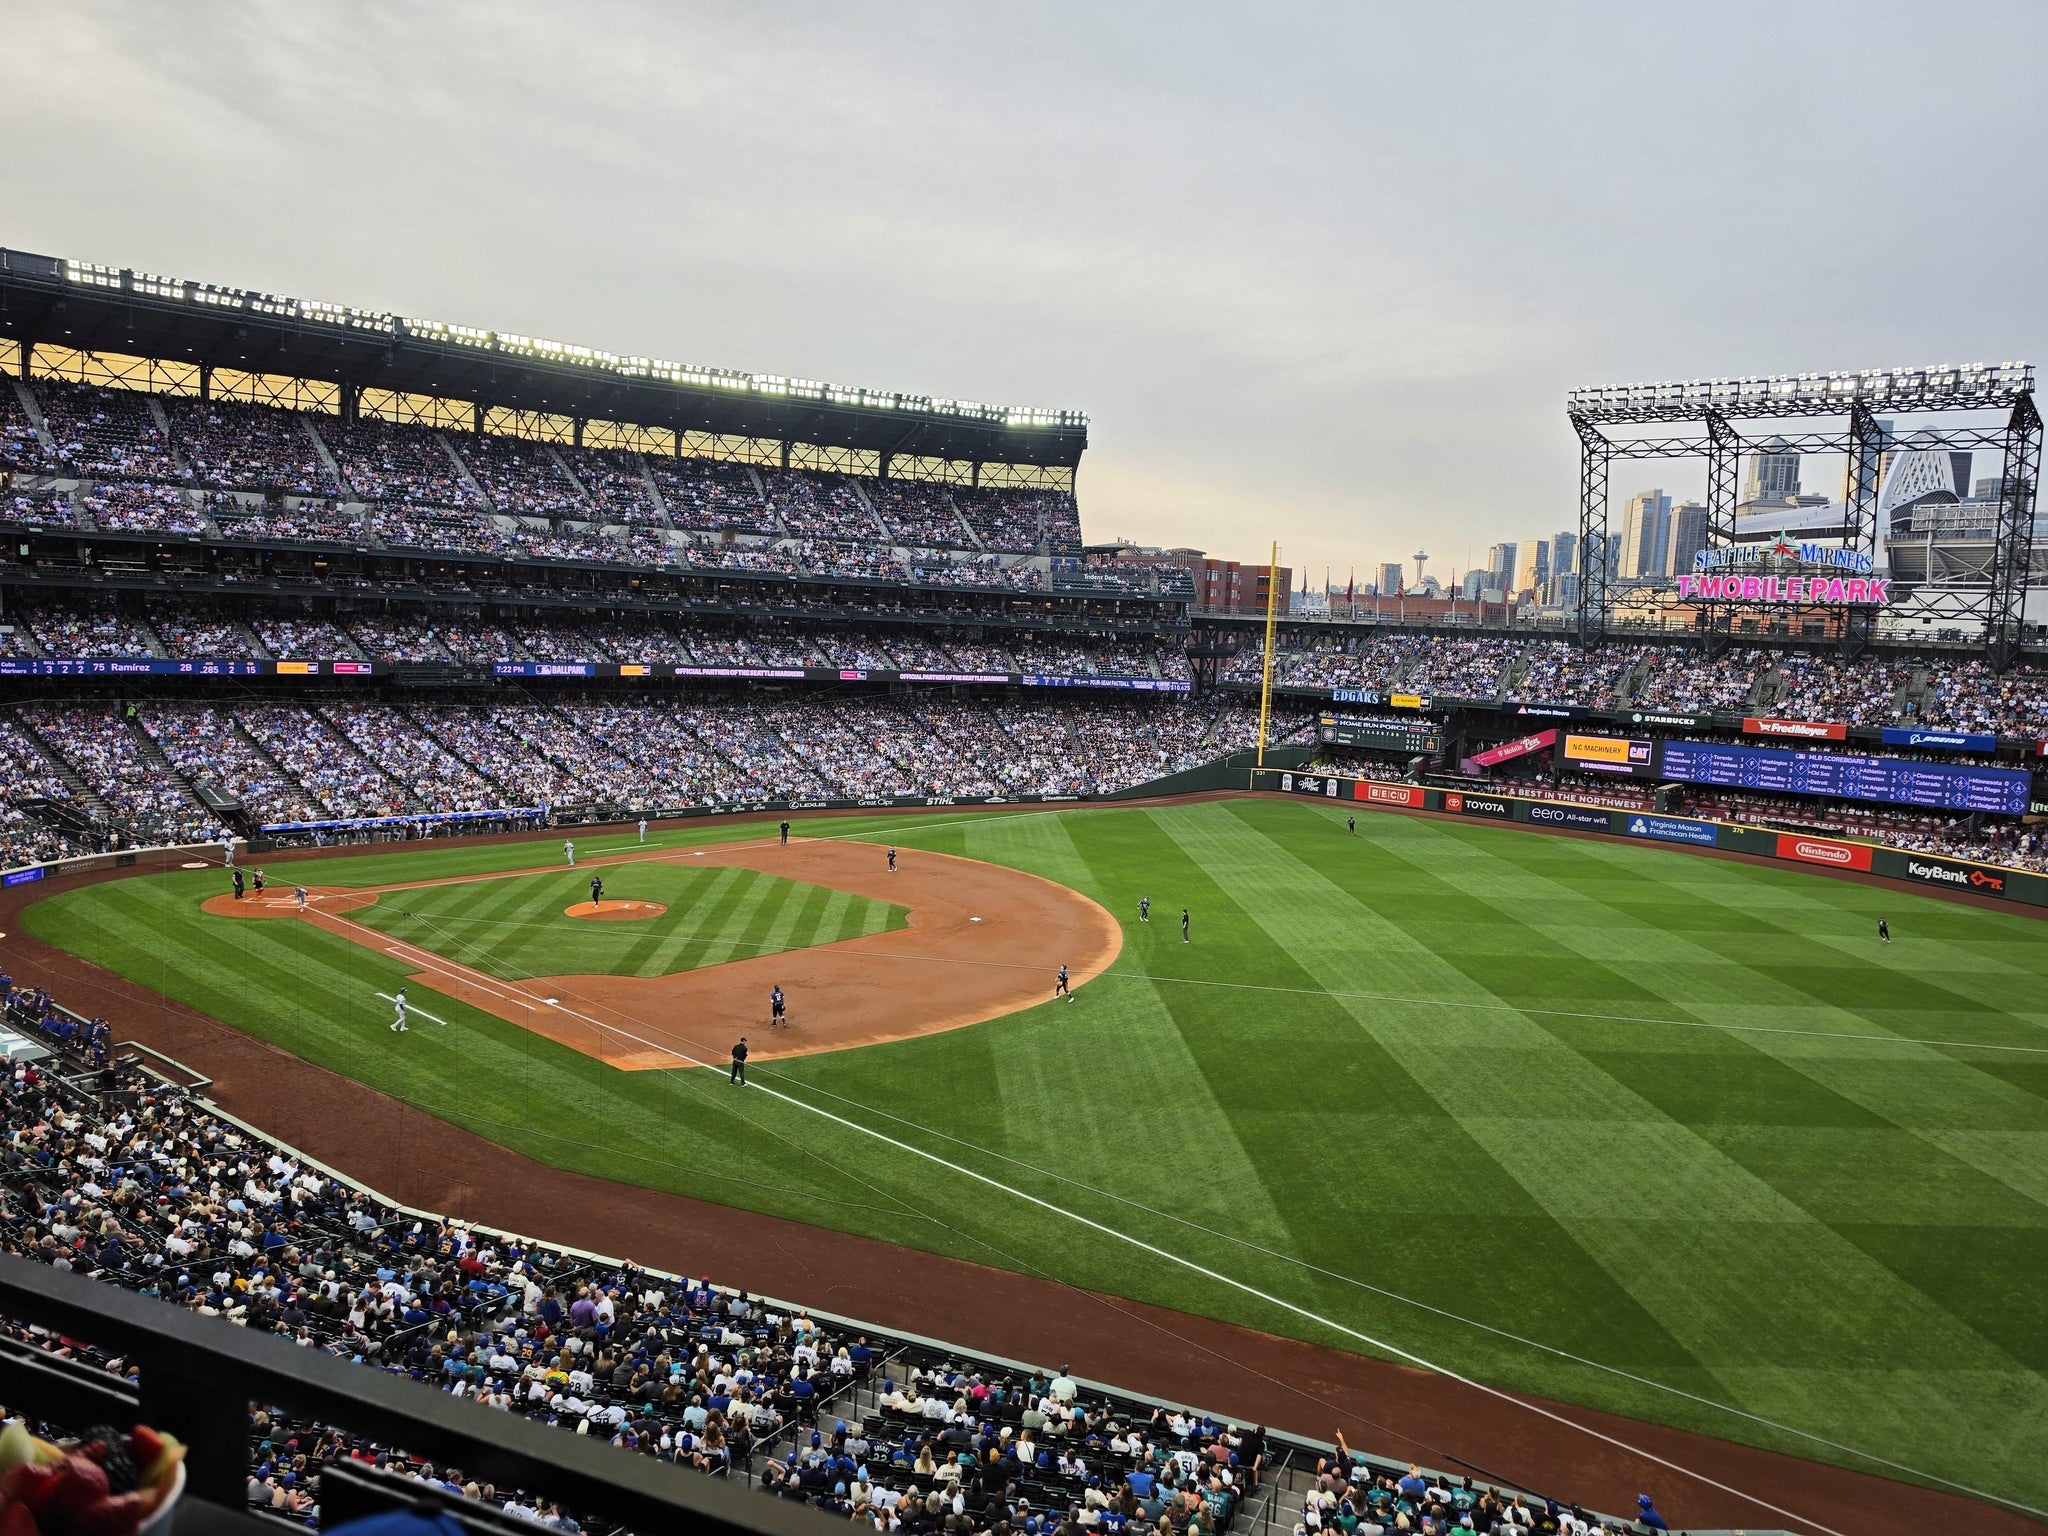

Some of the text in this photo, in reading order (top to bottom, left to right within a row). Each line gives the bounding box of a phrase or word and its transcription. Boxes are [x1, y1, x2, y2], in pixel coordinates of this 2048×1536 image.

[1695, 542, 1873, 574] SEATTLE MARINERS
[1677, 575, 1892, 603] T-MOBILE PARK
[46, 666, 84, 674] 3 2 2
[93, 663, 150, 672] 75 Ramírez
[180, 663, 192, 672] 2B
[200, 666, 256, 674] .285 2 15
[552, 665, 586, 675] BALLPARK
[1332, 689, 1380, 705] EDGARS
[1528, 708, 1569, 717] Benjamin Moore
[1644, 715, 1695, 725] STARBUCKS
[1340, 720, 1362, 728] HOME
[1380, 723, 1408, 731] PORCH
[1923, 735, 1966, 745] BOEING
[1503, 744, 1523, 756] Mobile
[1584, 744, 1622, 754] MACHINERY
[1629, 746, 1650, 759] CAT
[1823, 755, 1866, 765] SCOREBOARD
[1915, 789, 1942, 797] Cincinnati
[1984, 786, 2001, 794] Diego
[877, 798, 893, 806] Clips
[926, 797, 955, 805] STIHL
[1518, 789, 1542, 798] BEST
[1557, 793, 1576, 802] THE
[1579, 795, 1643, 810] NORTHWEST
[1970, 794, 2000, 803] Pittsburgh
[1466, 800, 1505, 813] TOYOTA
[1531, 807, 1564, 821] eero
[1566, 813, 1608, 825] All-star wifi.
[1649, 821, 1702, 832] Virginia Mason
[1649, 828, 1712, 841] Franciscan Health
[1847, 826, 1858, 834] IN
[1862, 828, 1885, 838] THE
[1800, 845, 1848, 859] Nintendo
[1909, 862, 1968, 884] KeyBank
[694, 1296, 707, 1306] 44
[754, 1416, 769, 1425] 57
[1182, 1461, 1192, 1471] 51
[1457, 1501, 1469, 1509] 44
